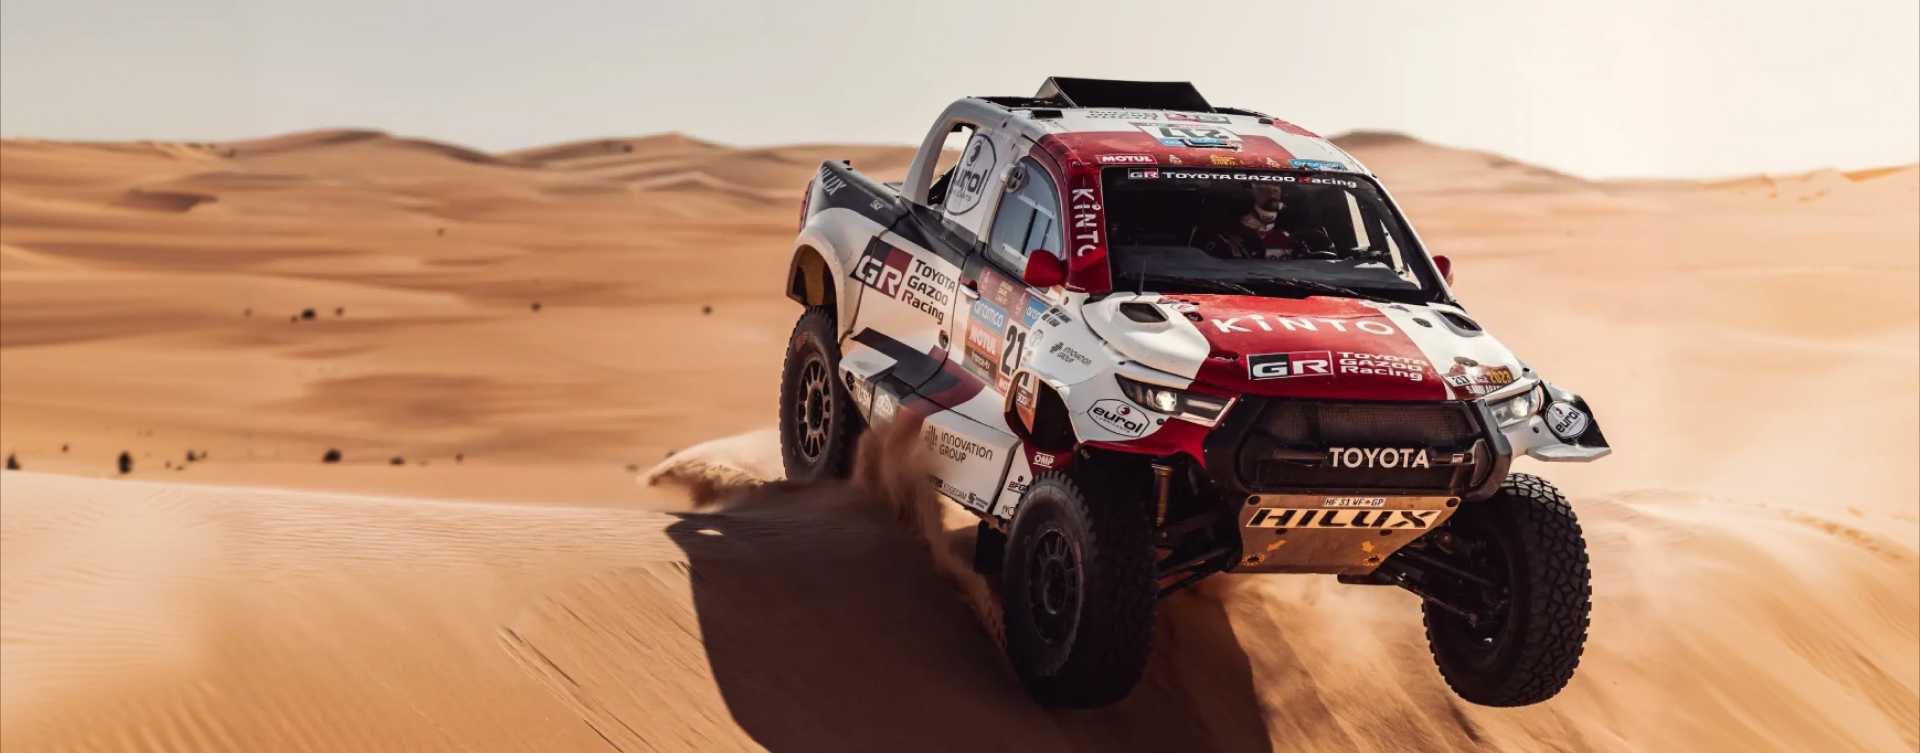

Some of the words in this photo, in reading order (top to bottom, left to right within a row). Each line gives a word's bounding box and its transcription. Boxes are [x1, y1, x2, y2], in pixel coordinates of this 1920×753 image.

[1102, 155, 1154, 163] MOTUL
[1129, 171, 1159, 179] GR
[1162, 172, 1232, 180] TOYOTA
[1234, 173, 1295, 182] GAZOO
[1297, 176, 1357, 189] Racing
[855, 254, 903, 297] GR
[915, 259, 956, 293] TOYOTA
[907, 275, 949, 306] GAZOO
[901, 289, 945, 325] Racing
[974, 300, 1004, 327] aramco
[1336, 351, 1428, 366] TOYOTA
[1339, 358, 1423, 371] GAZOO
[1252, 359, 1330, 378] GR
[1340, 365, 1423, 381] Racing
[1486, 370, 1512, 385] 2023
[1092, 406, 1144, 434] eurol
[1555, 406, 1581, 433] eurol
[939, 444, 967, 463] GROUP
[1034, 454, 1055, 466] OMP
[1329, 448, 1430, 468] TOYOTA
[1371, 498, 1384, 506] GP
[1249, 508, 1438, 528] HILUX
